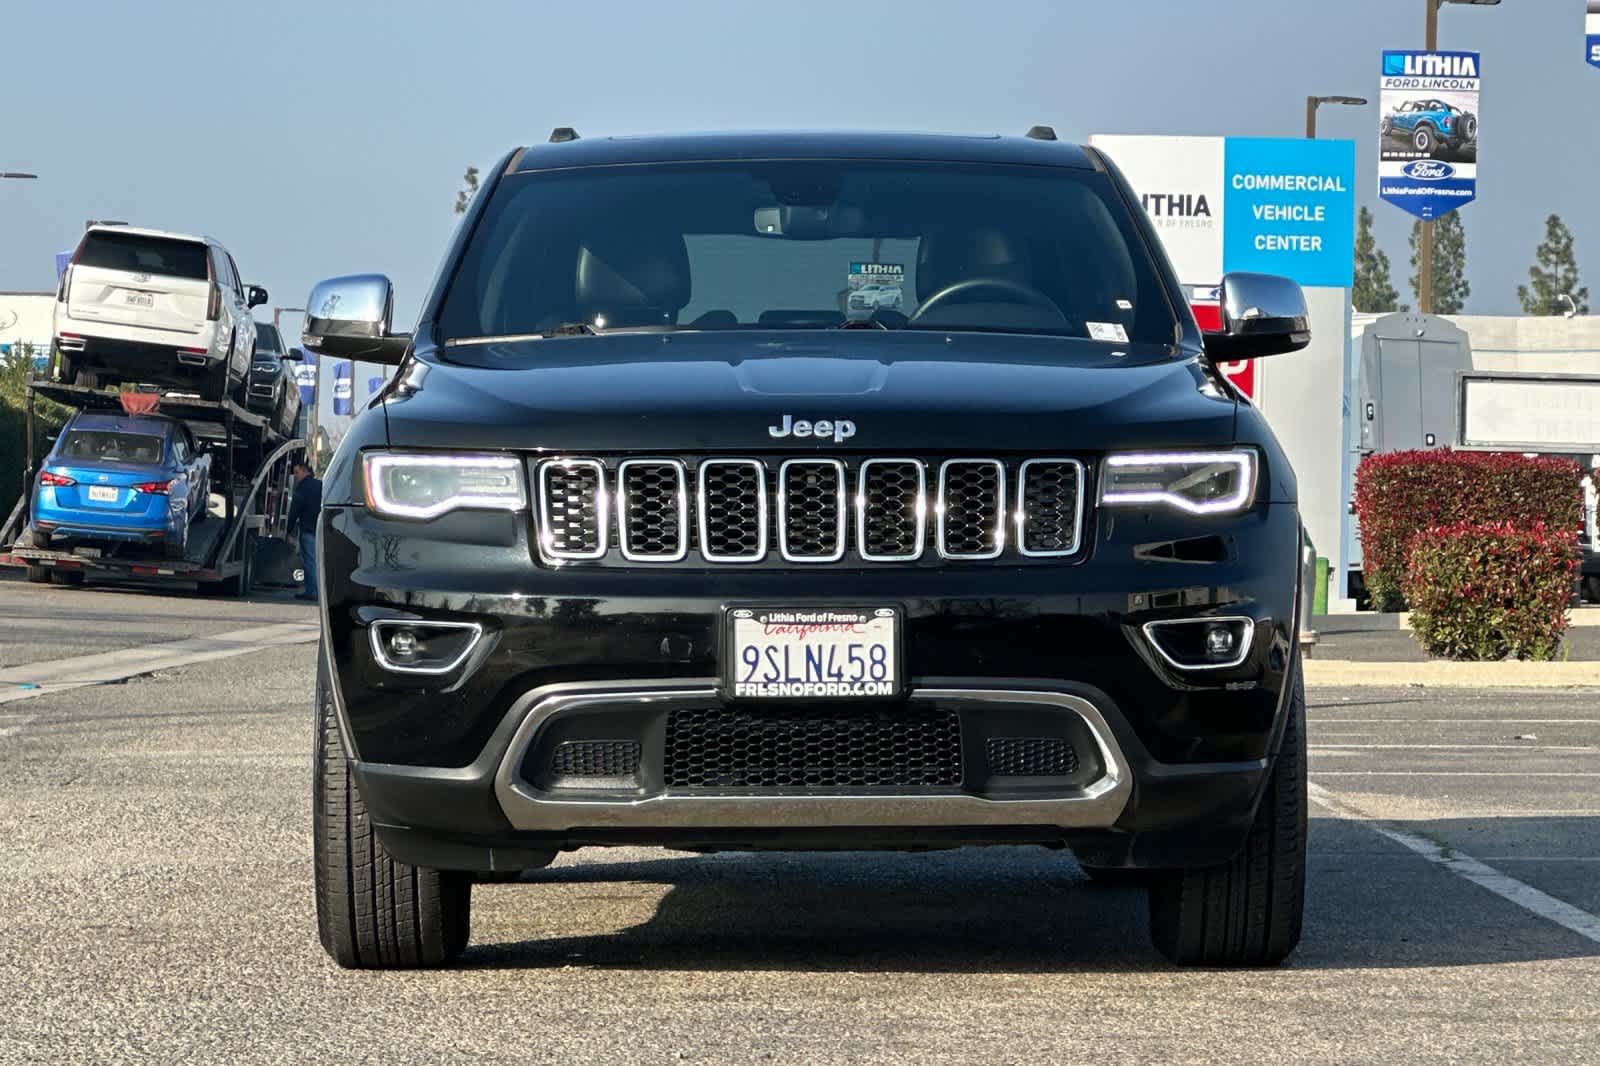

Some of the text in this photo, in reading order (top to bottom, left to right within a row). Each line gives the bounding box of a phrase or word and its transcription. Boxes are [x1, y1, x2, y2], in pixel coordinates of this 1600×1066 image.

[1404, 55, 1476, 76] LITHIA
[1385, 78, 1475, 90] FORD LINCOLN
[1410, 162, 1445, 177] Ford
[1232, 174, 1346, 192] COMMERCIAL
[1142, 194, 1212, 217] ITHIA
[1253, 204, 1325, 221] VEHICLE
[1254, 235, 1322, 251] CENTER
[768, 414, 857, 443] Jeep
[769, 612, 858, 623] Lithia Ford of Fresno
[742, 643, 887, 683] 9SLN458
[735, 682, 893, 697] FRESNOFORD.COM
